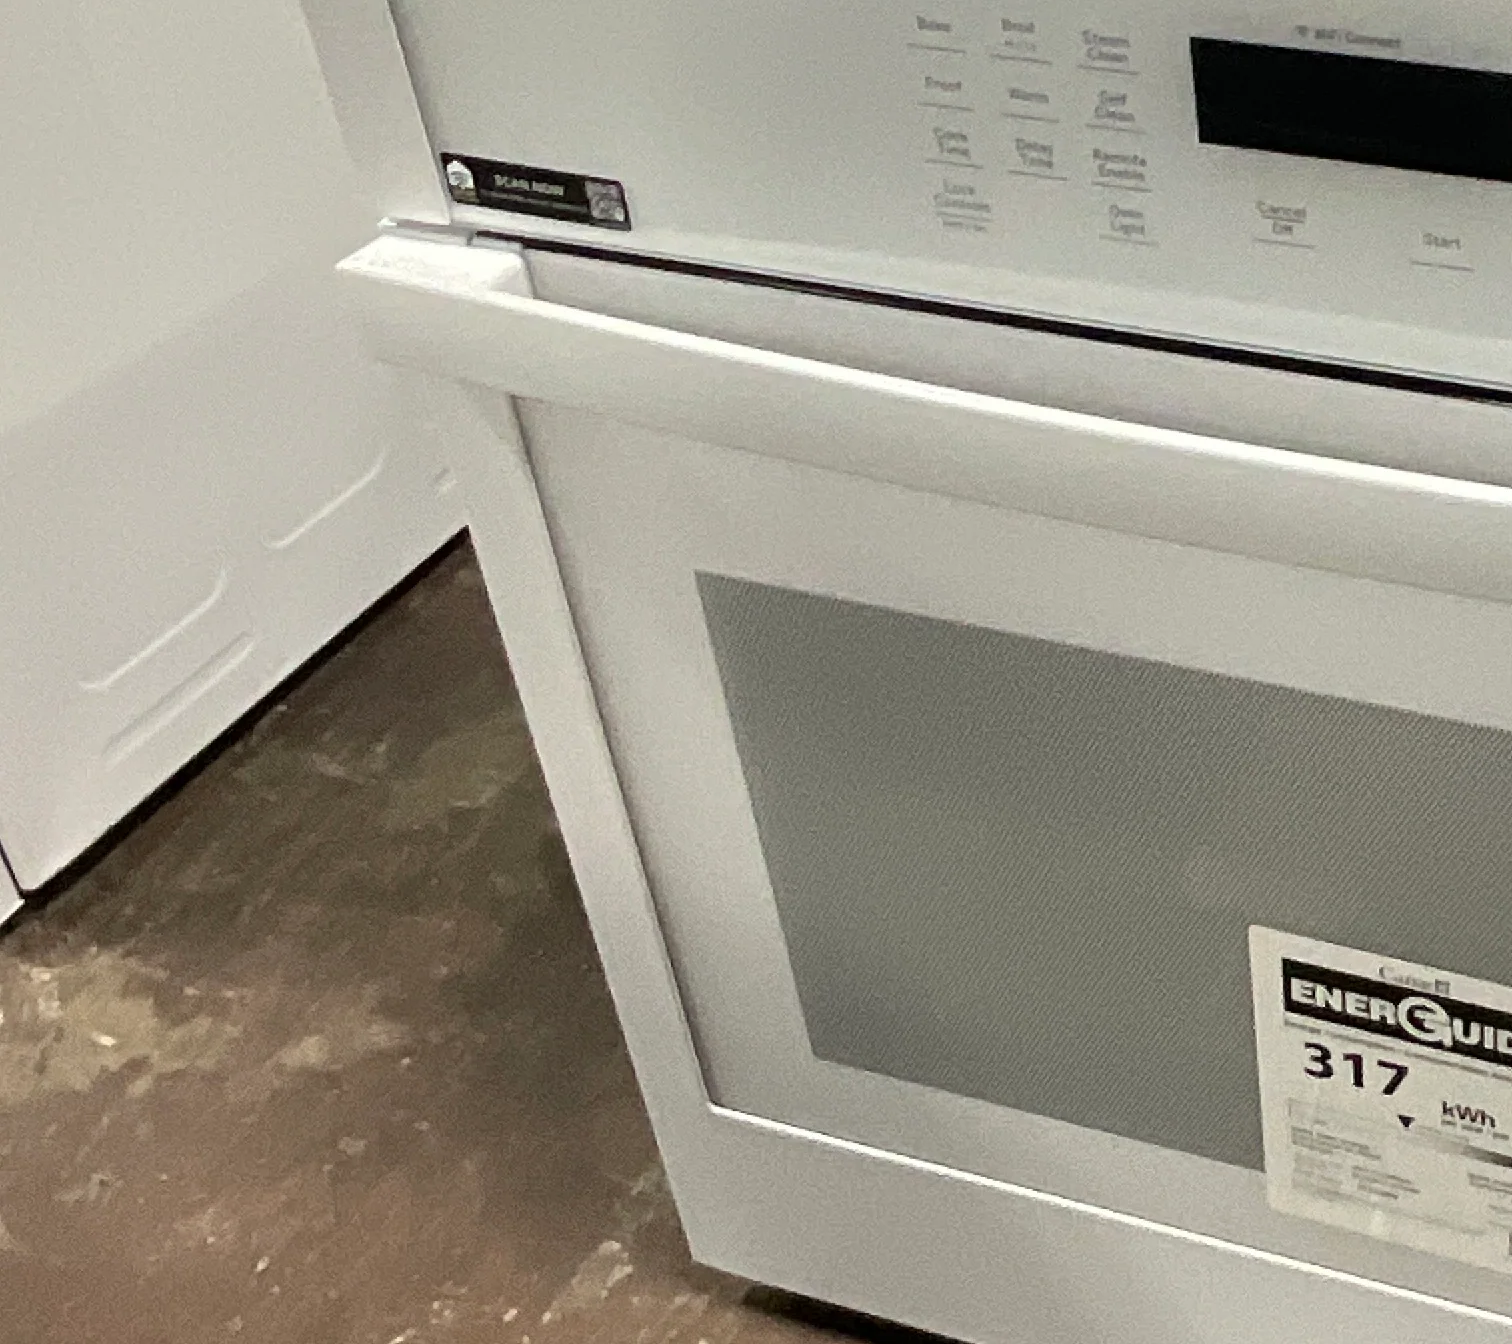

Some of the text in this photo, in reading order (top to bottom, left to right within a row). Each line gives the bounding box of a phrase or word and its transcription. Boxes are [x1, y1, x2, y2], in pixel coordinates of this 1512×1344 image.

[1255, 200, 1307, 220] Cancel
[1422, 232, 1461, 250] Start
[1303, 1042, 1411, 1096] 317
[1442, 1100, 1496, 1128] kWh
